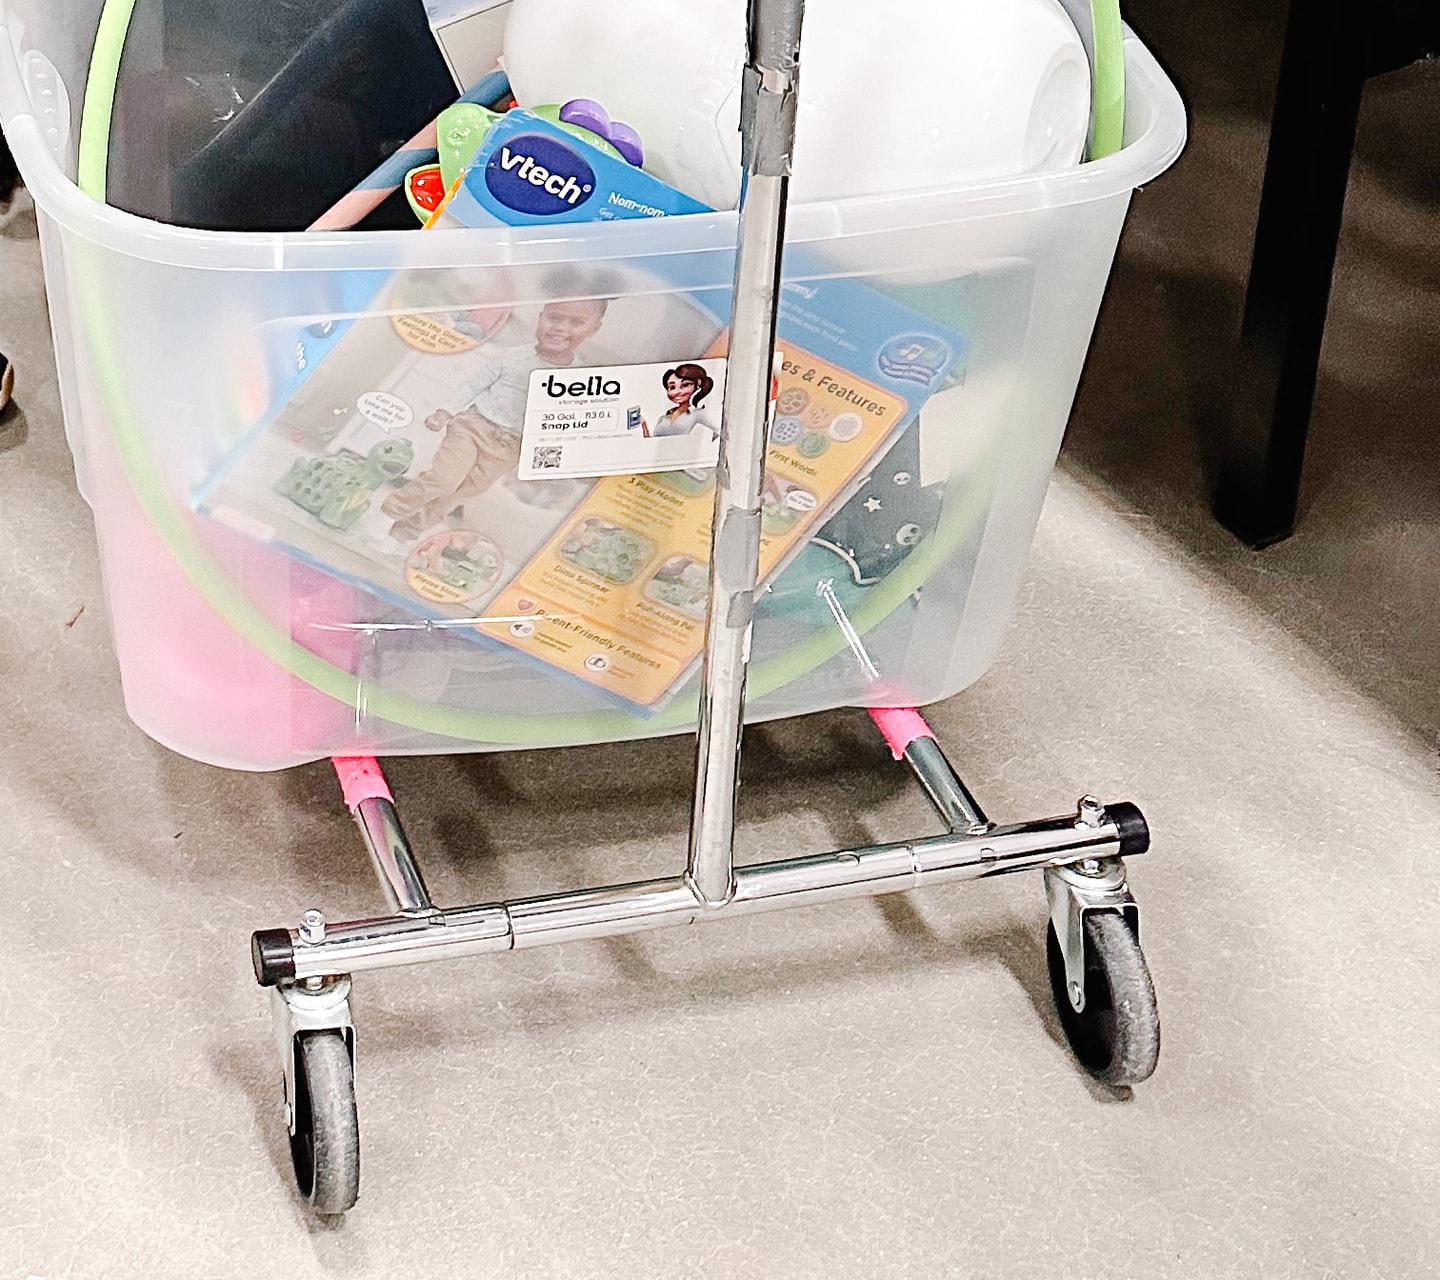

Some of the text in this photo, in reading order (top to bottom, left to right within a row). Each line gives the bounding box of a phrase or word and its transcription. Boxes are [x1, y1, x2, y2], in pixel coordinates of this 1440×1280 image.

[501, 146, 582, 205] vtech
[607, 191, 666, 217] Nom-nom
[542, 374, 621, 398] bella
[802, 369, 817, 383] &
[816, 376, 887, 417] Features
[541, 421, 589, 431] Snap Lid
[535, 608, 615, 650] Pent-Friendly
